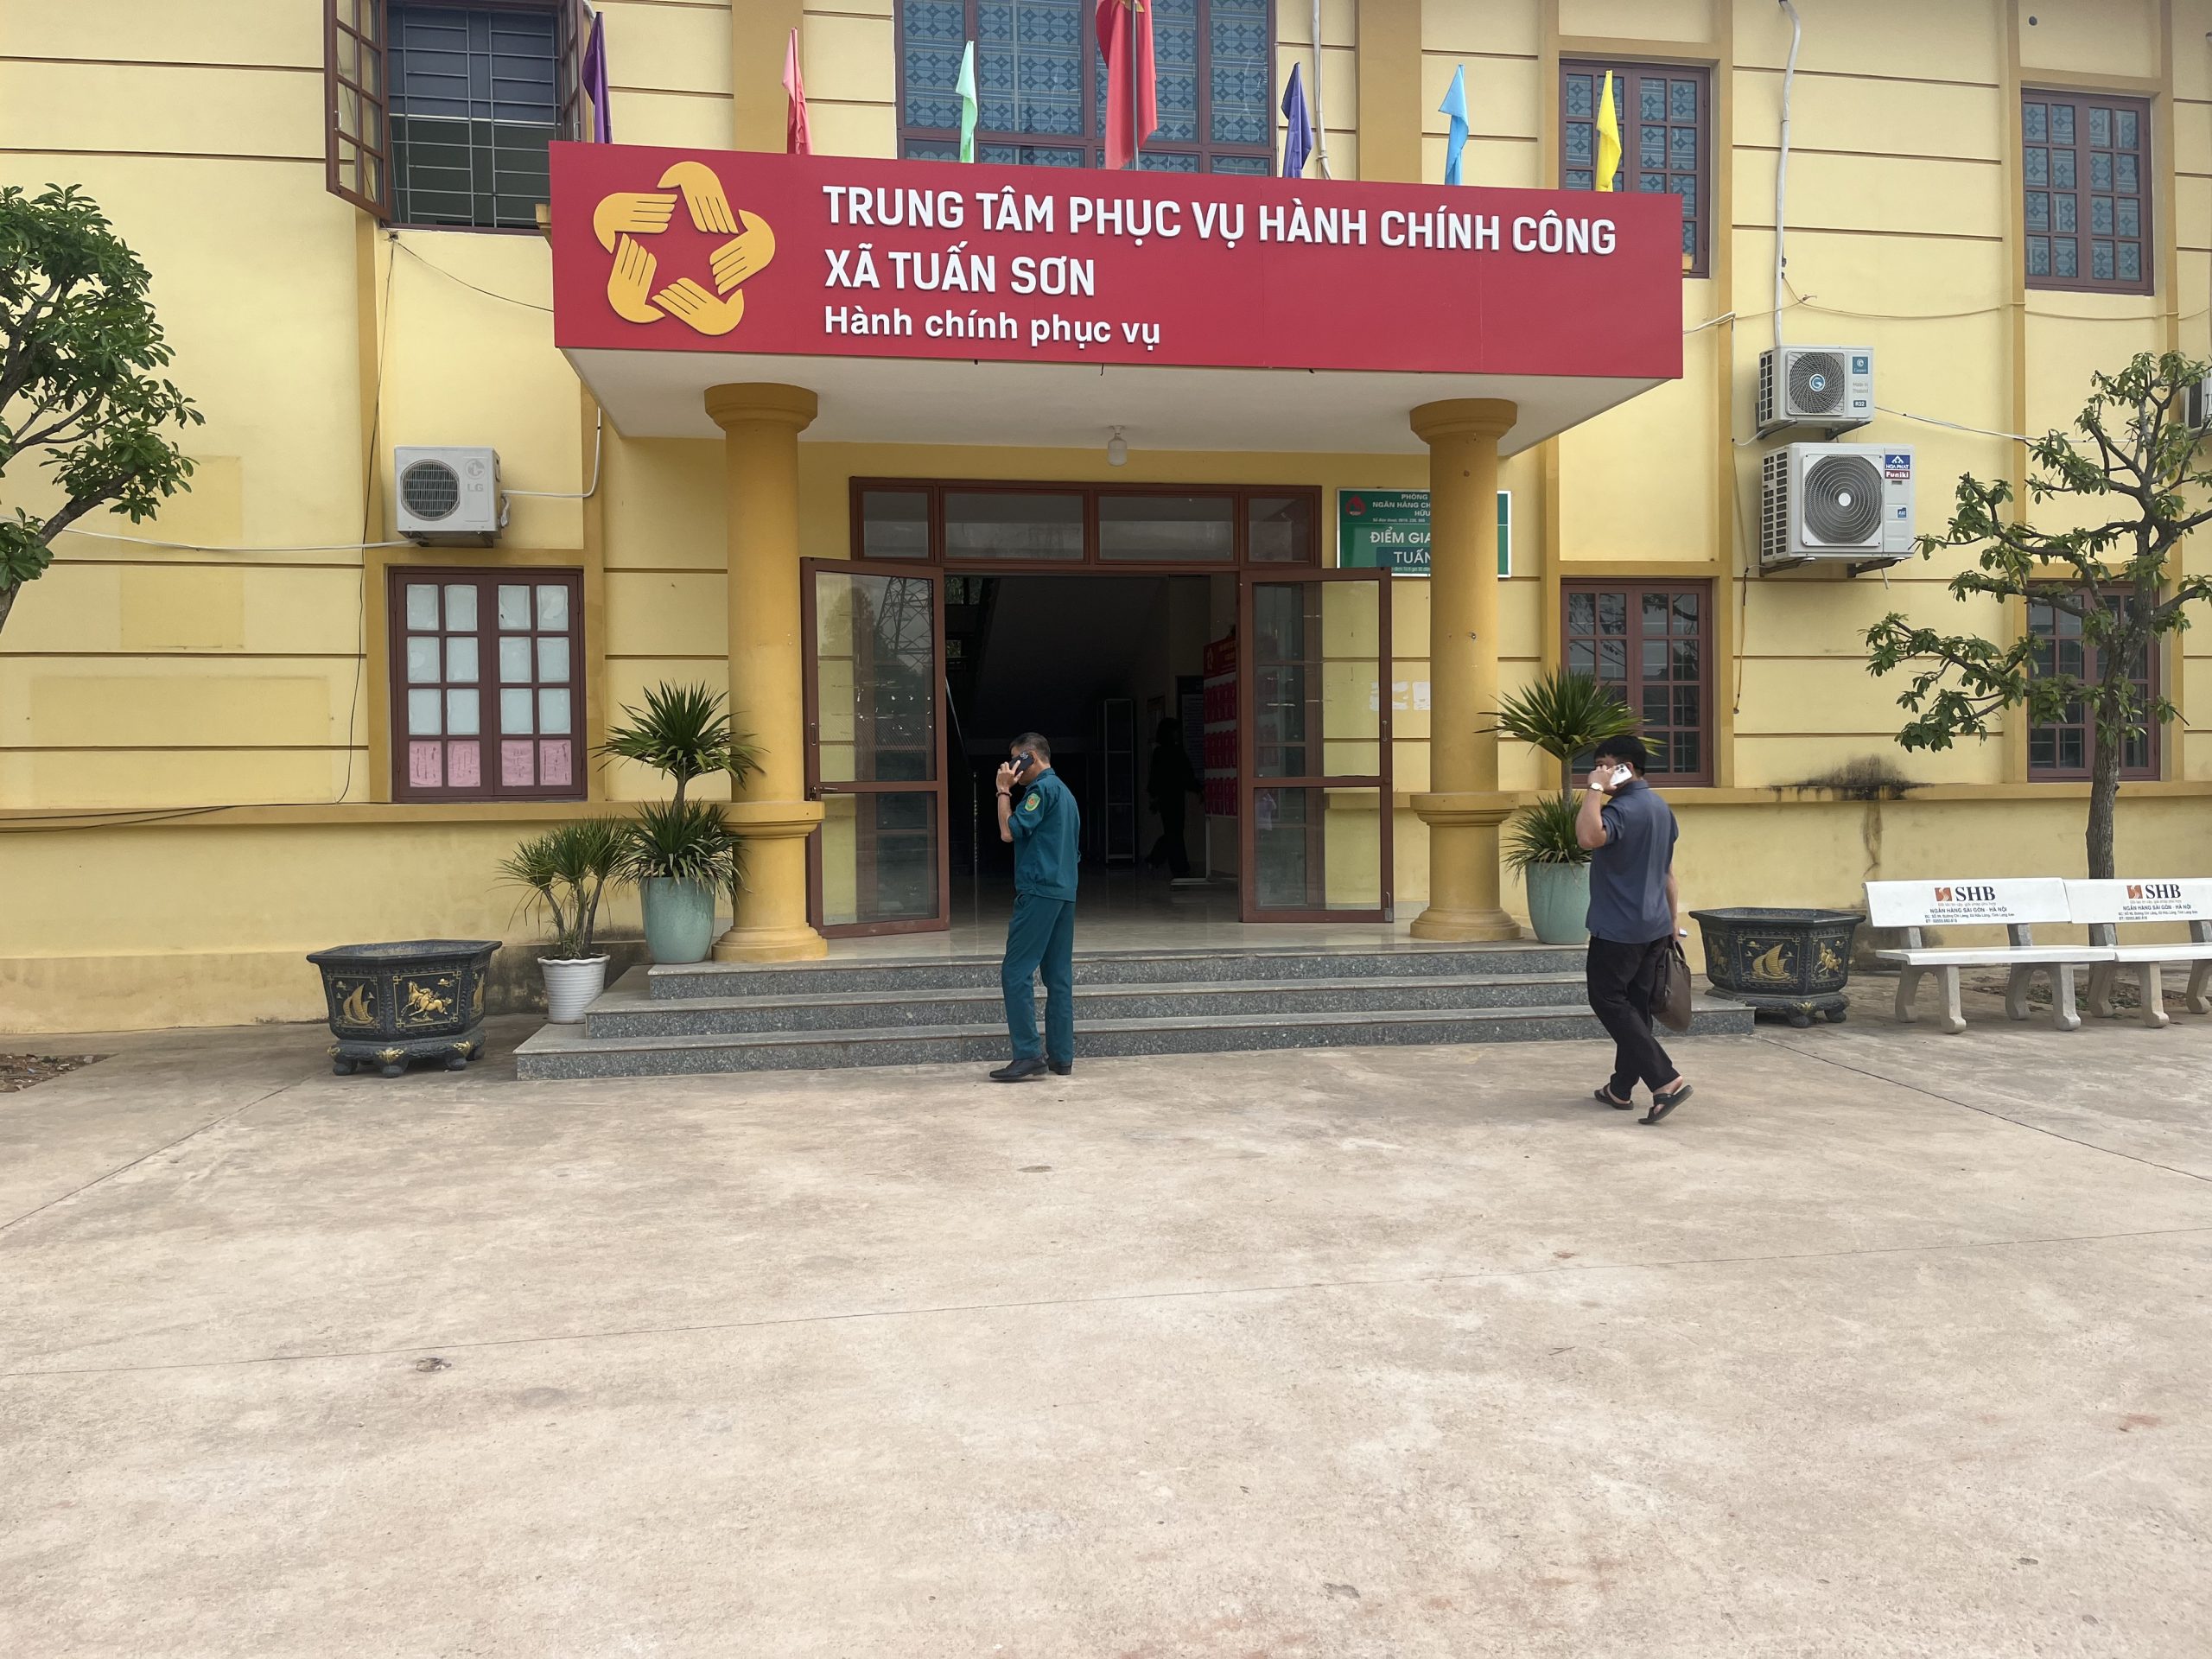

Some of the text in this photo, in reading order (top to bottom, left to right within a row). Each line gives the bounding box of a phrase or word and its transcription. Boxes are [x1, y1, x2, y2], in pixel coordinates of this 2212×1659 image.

[822, 185, 1616, 255] TRUNG TÂM PHỤC VỤ HÀNH CHÍNH CÔNG
[824, 240, 1095, 296] XÃ TUẤN SƠN
[825, 305, 1160, 351] Hành chính phục vụ
[1370, 526, 1404, 543] ĐIỂM
[1955, 886, 1995, 901] SHB
[2145, 883, 2181, 899] SHB
